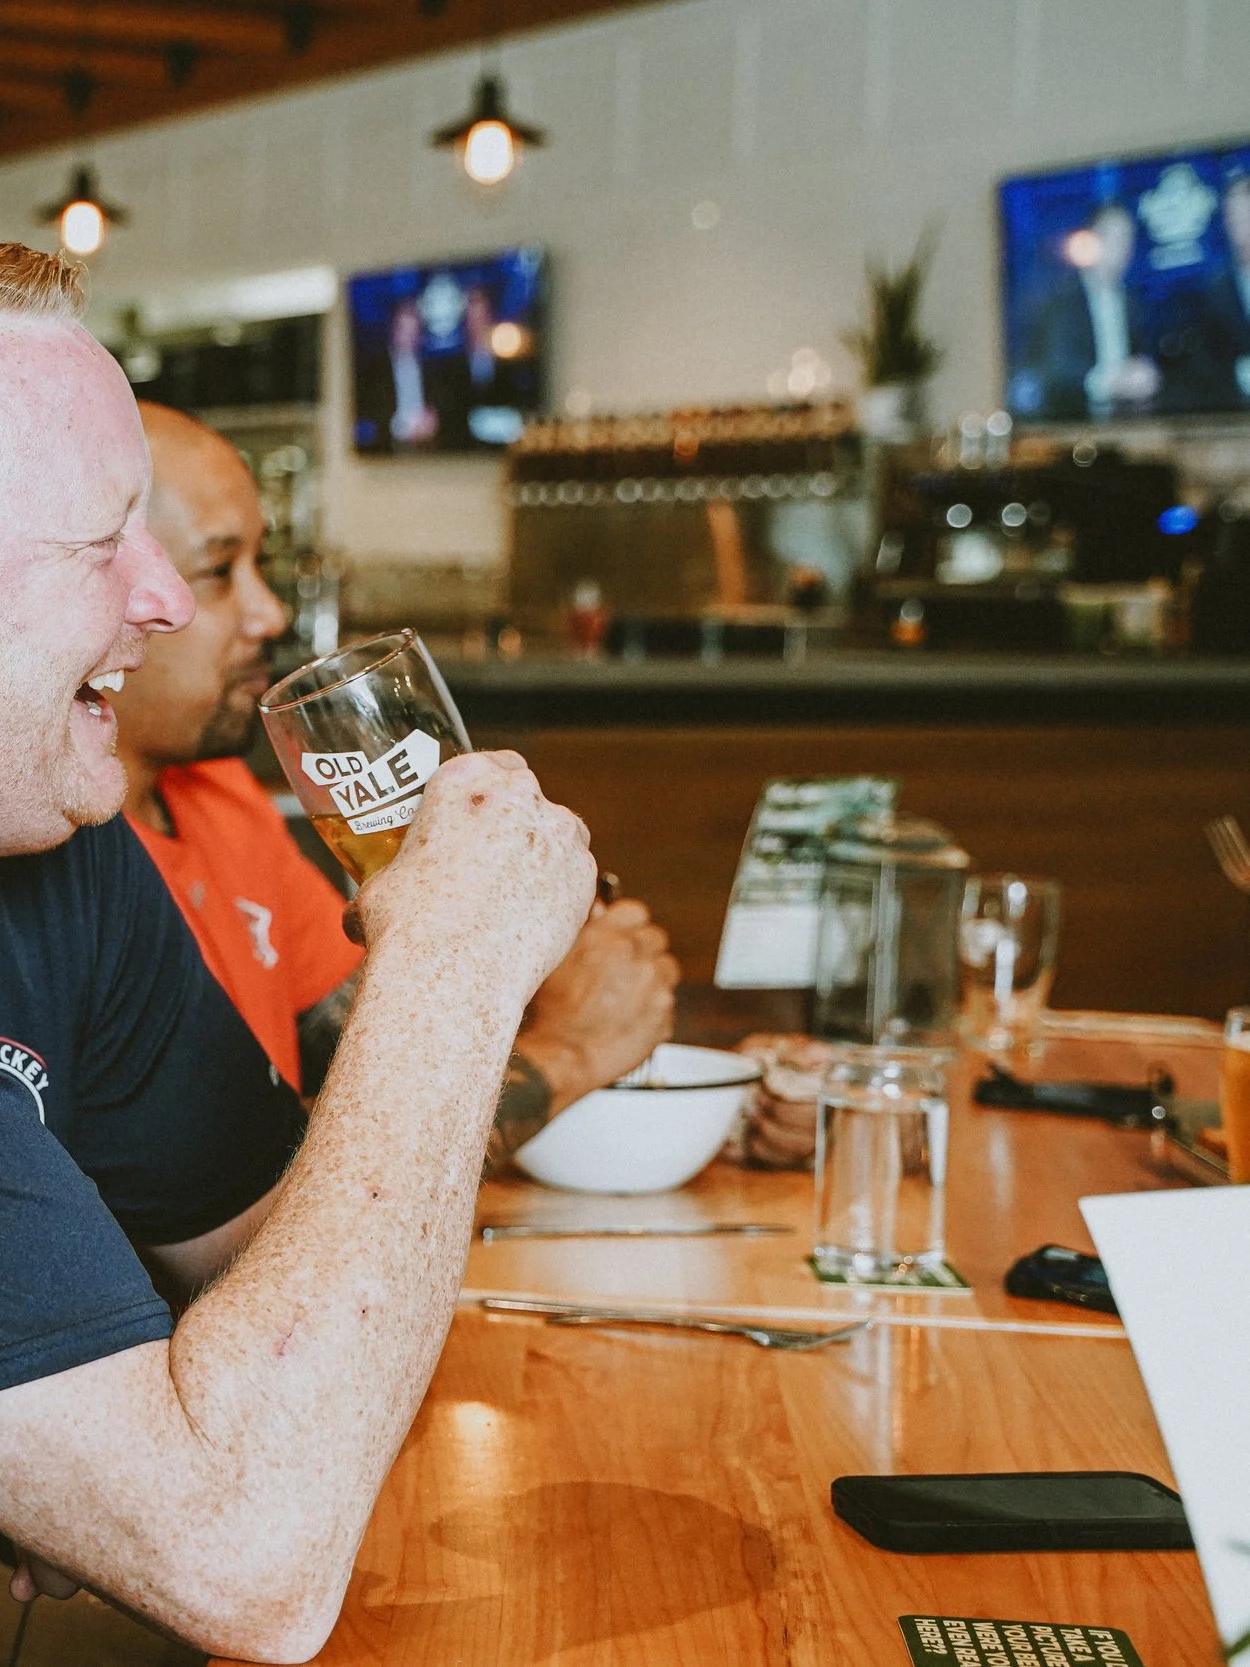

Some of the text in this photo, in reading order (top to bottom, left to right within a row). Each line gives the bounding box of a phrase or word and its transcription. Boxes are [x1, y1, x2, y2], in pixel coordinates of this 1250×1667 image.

[315, 756, 363, 780] OLD
[336, 749, 419, 811] YALE
[354, 815, 394, 831] Brewing
[914, 1618, 948, 1655] HERE??
[943, 1620, 974, 1646] EVEN
[972, 1622, 1011, 1667] WERE YO
[1002, 1624, 1041, 1667] YOUR BE
[1060, 1628, 1096, 1661] TAKE A
[1088, 1629, 1114, 1640] IF
[1094, 1640, 1126, 1662] YOU
